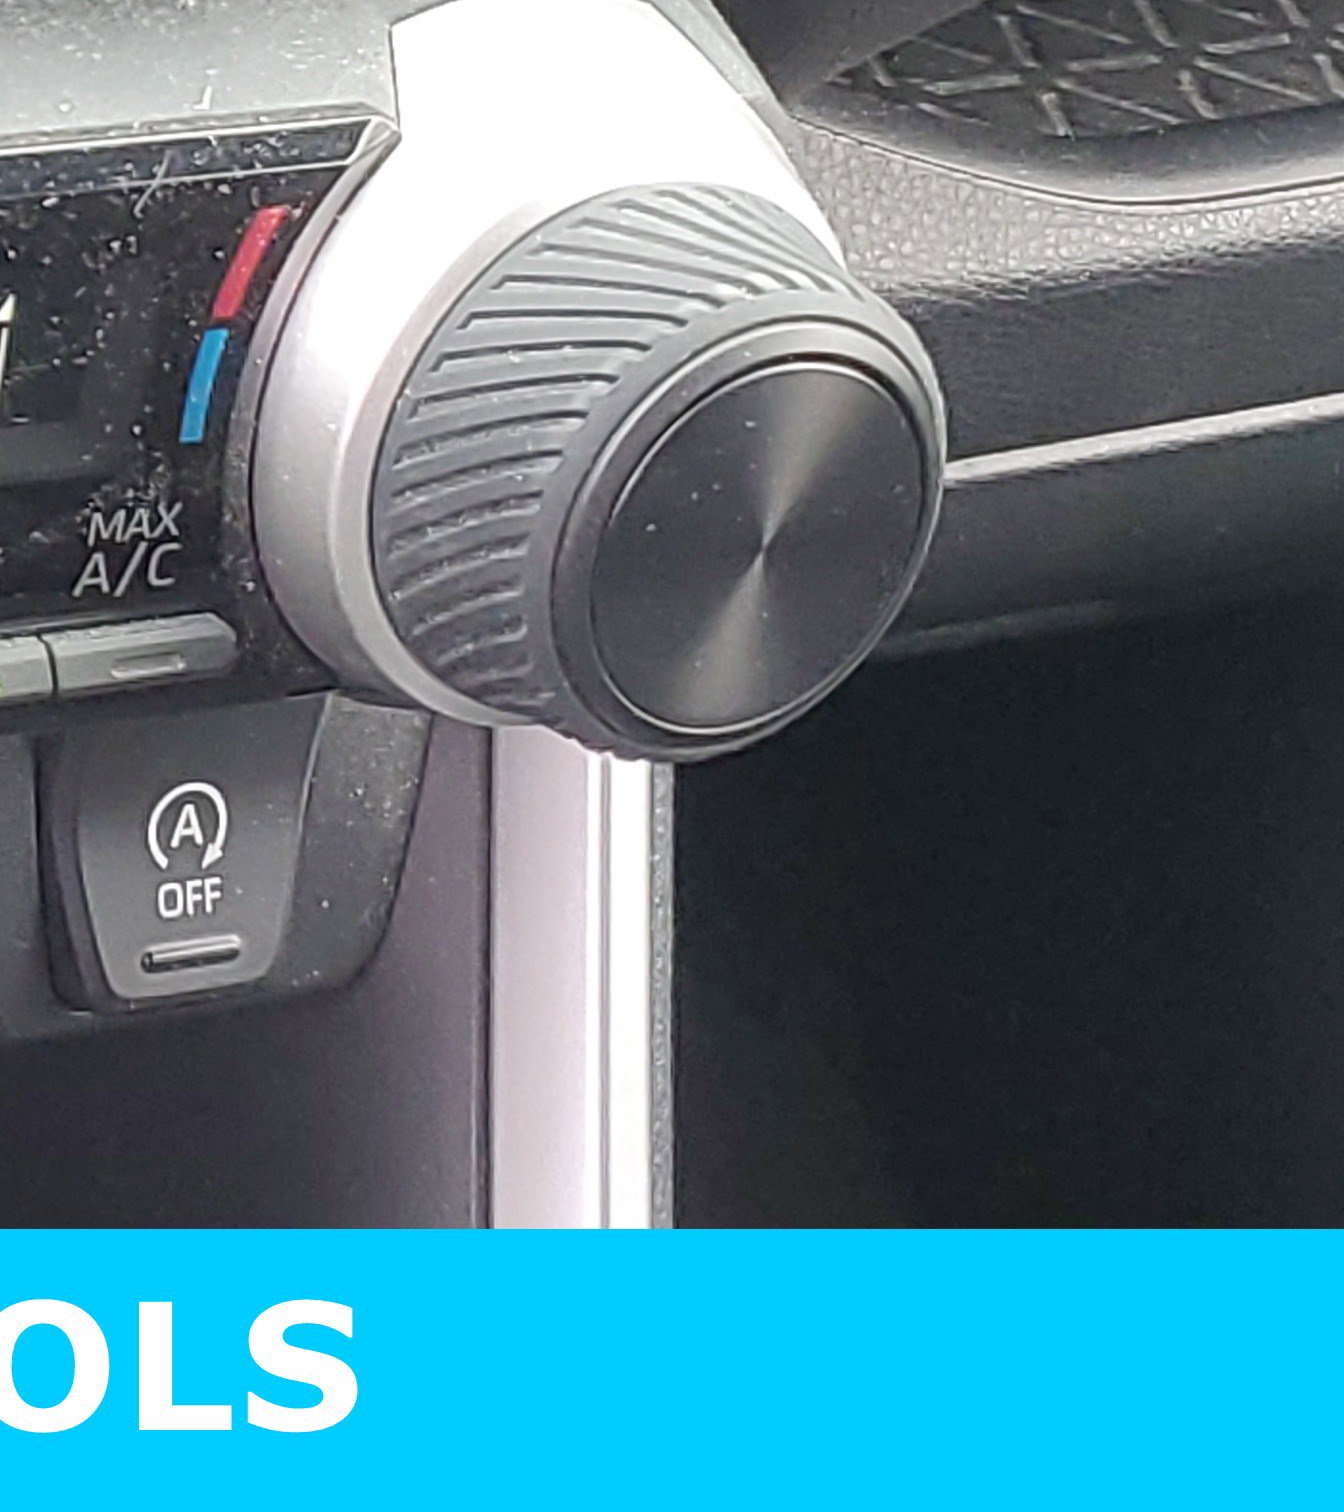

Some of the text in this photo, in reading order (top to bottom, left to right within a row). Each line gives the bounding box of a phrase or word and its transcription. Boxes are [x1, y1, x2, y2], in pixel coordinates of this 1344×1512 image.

[87, 501, 182, 546] MAX
[72, 542, 183, 597] A/C
[158, 876, 222, 919] OFF
